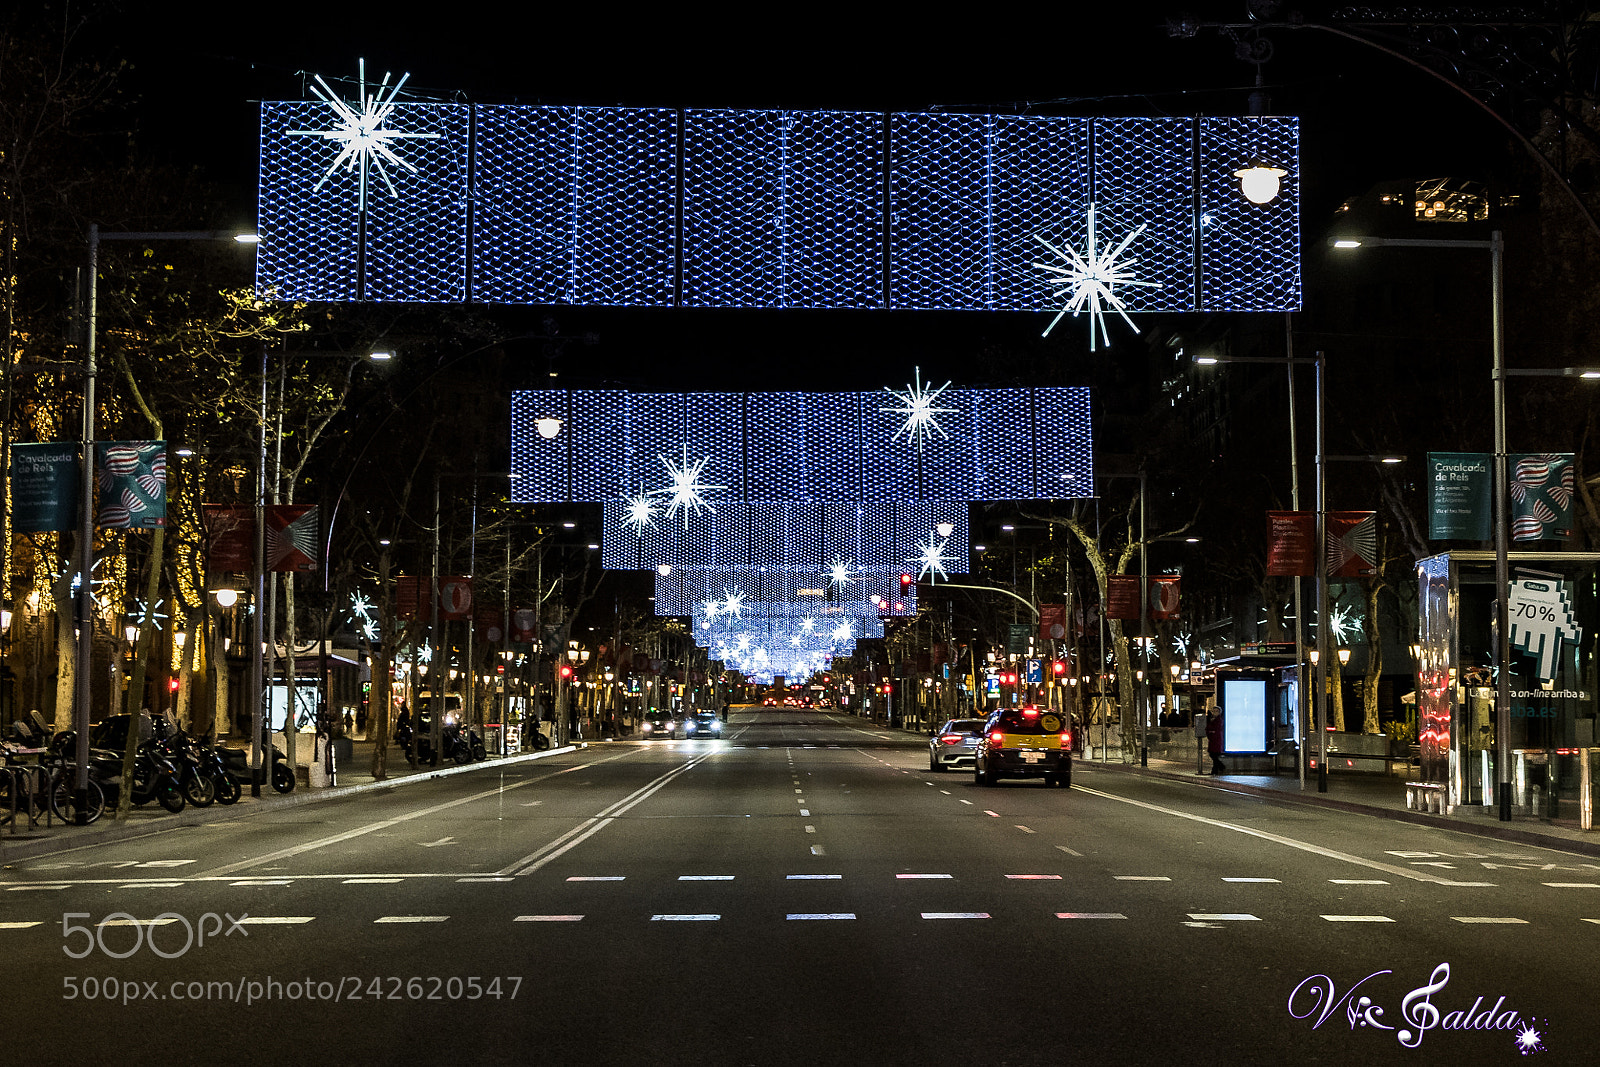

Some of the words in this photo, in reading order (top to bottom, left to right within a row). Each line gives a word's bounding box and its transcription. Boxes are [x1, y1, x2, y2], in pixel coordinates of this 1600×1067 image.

[18, 453, 72, 463] Cavalcada
[18, 463, 30, 473] de
[32, 463, 54, 472] Reis
[1435, 462, 1486, 472] Cavalcada
[1435, 472, 1447, 481] de
[1449, 472, 1469, 481] Reis
[1517, 688, 1550, 698] on-line
[1550, 689, 1578, 698] arriba
[1579, 690, 1585, 698] a
[1509, 703, 1557, 718] aba.es
